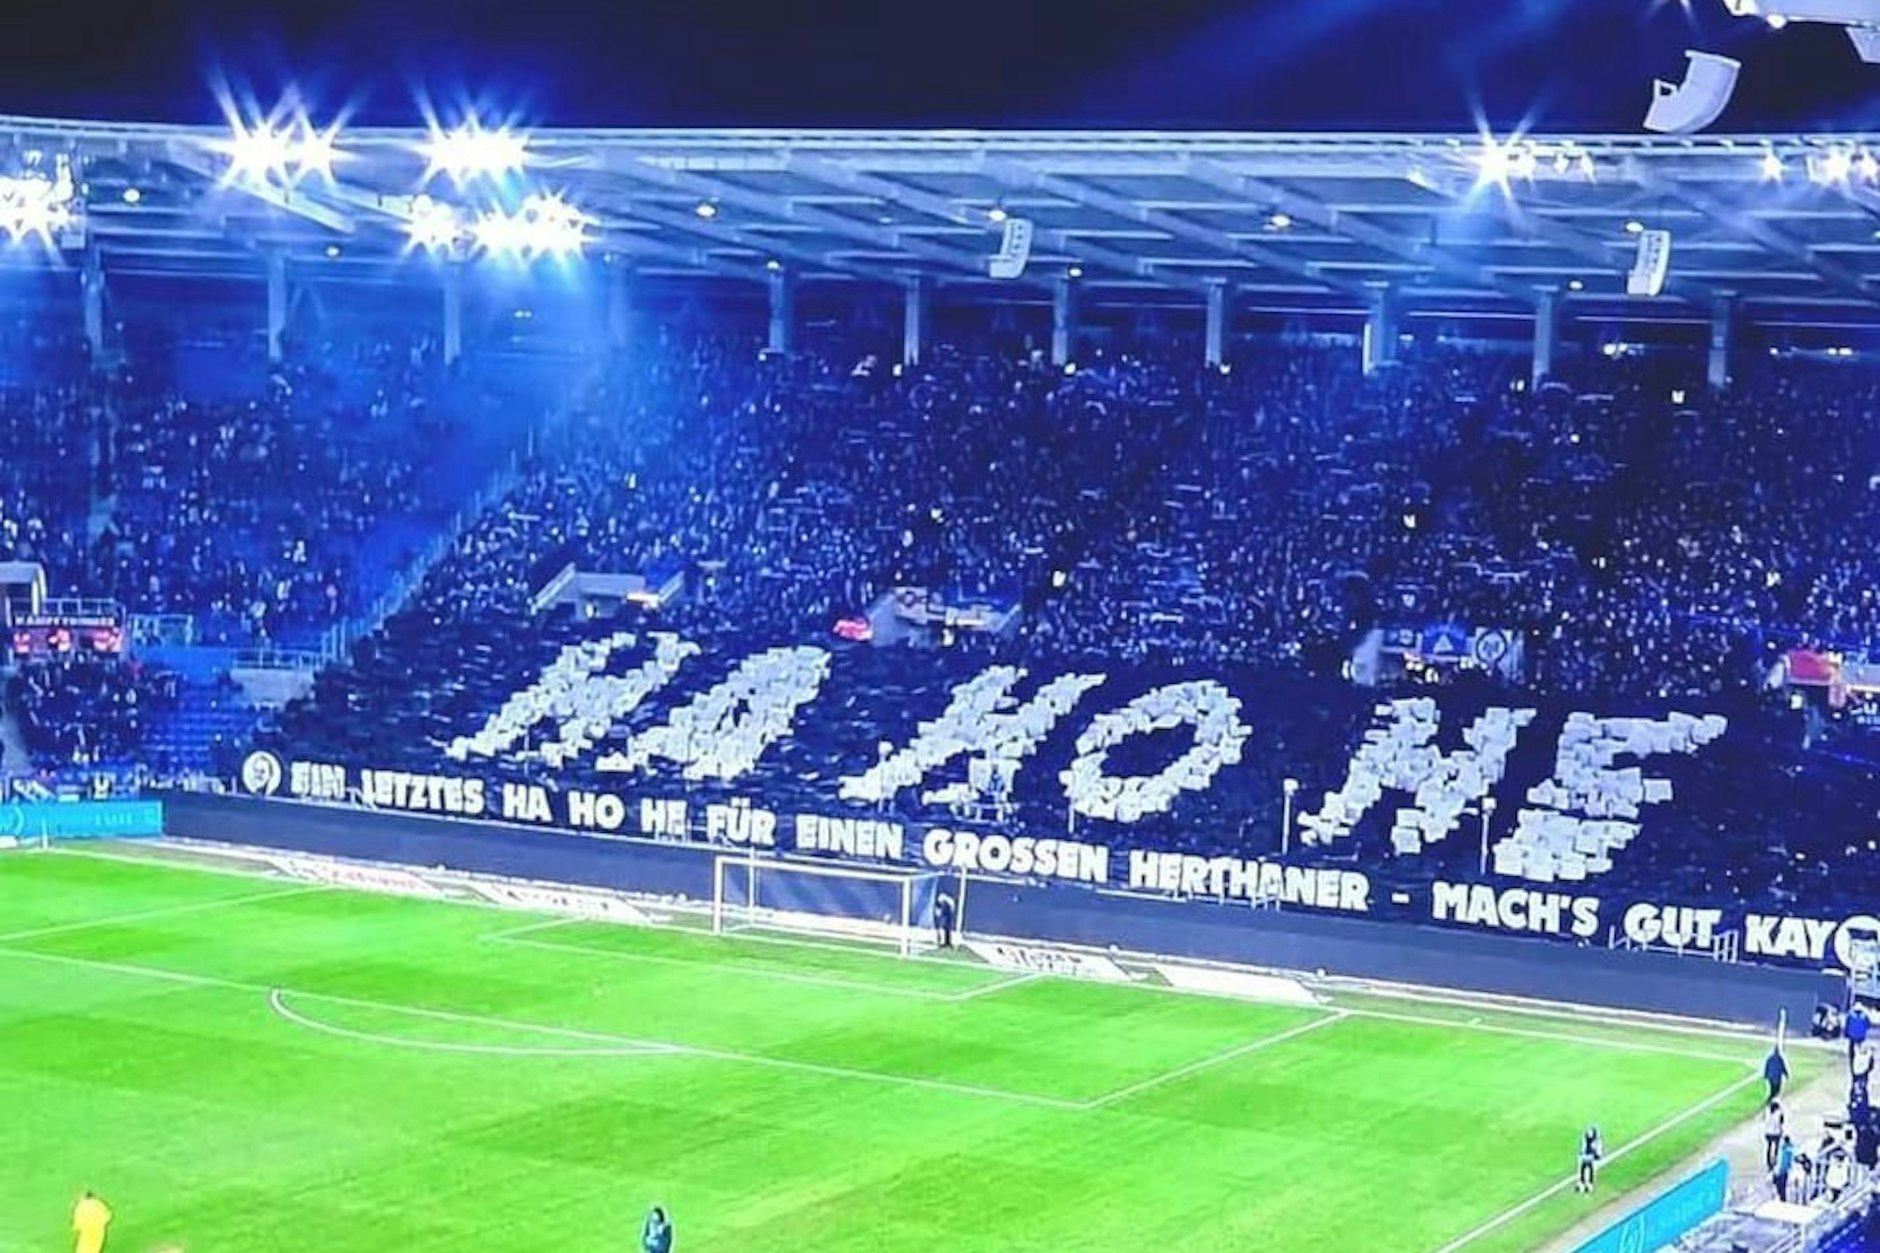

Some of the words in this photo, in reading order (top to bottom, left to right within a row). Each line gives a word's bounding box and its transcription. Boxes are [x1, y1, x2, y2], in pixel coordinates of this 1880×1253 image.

[290, 762, 346, 798] EIN
[361, 770, 485, 814] LETZTES
[503, 784, 552, 821] HA
[567, 791, 625, 830] HO
[641, 798, 688, 836] HE
[706, 798, 775, 846] FÜR
[797, 815, 902, 860] EINEN
[923, 829, 1109, 883] GROSSEN
[1130, 850, 1369, 911] HERTHANER
[1433, 882, 1599, 937] MACH'S
[1625, 904, 1723, 946] GUT
[1745, 915, 1838, 959] KAY
[446, 631, 831, 780] HA
[838, 665, 1252, 822] HO
[1298, 697, 1728, 882] HE
